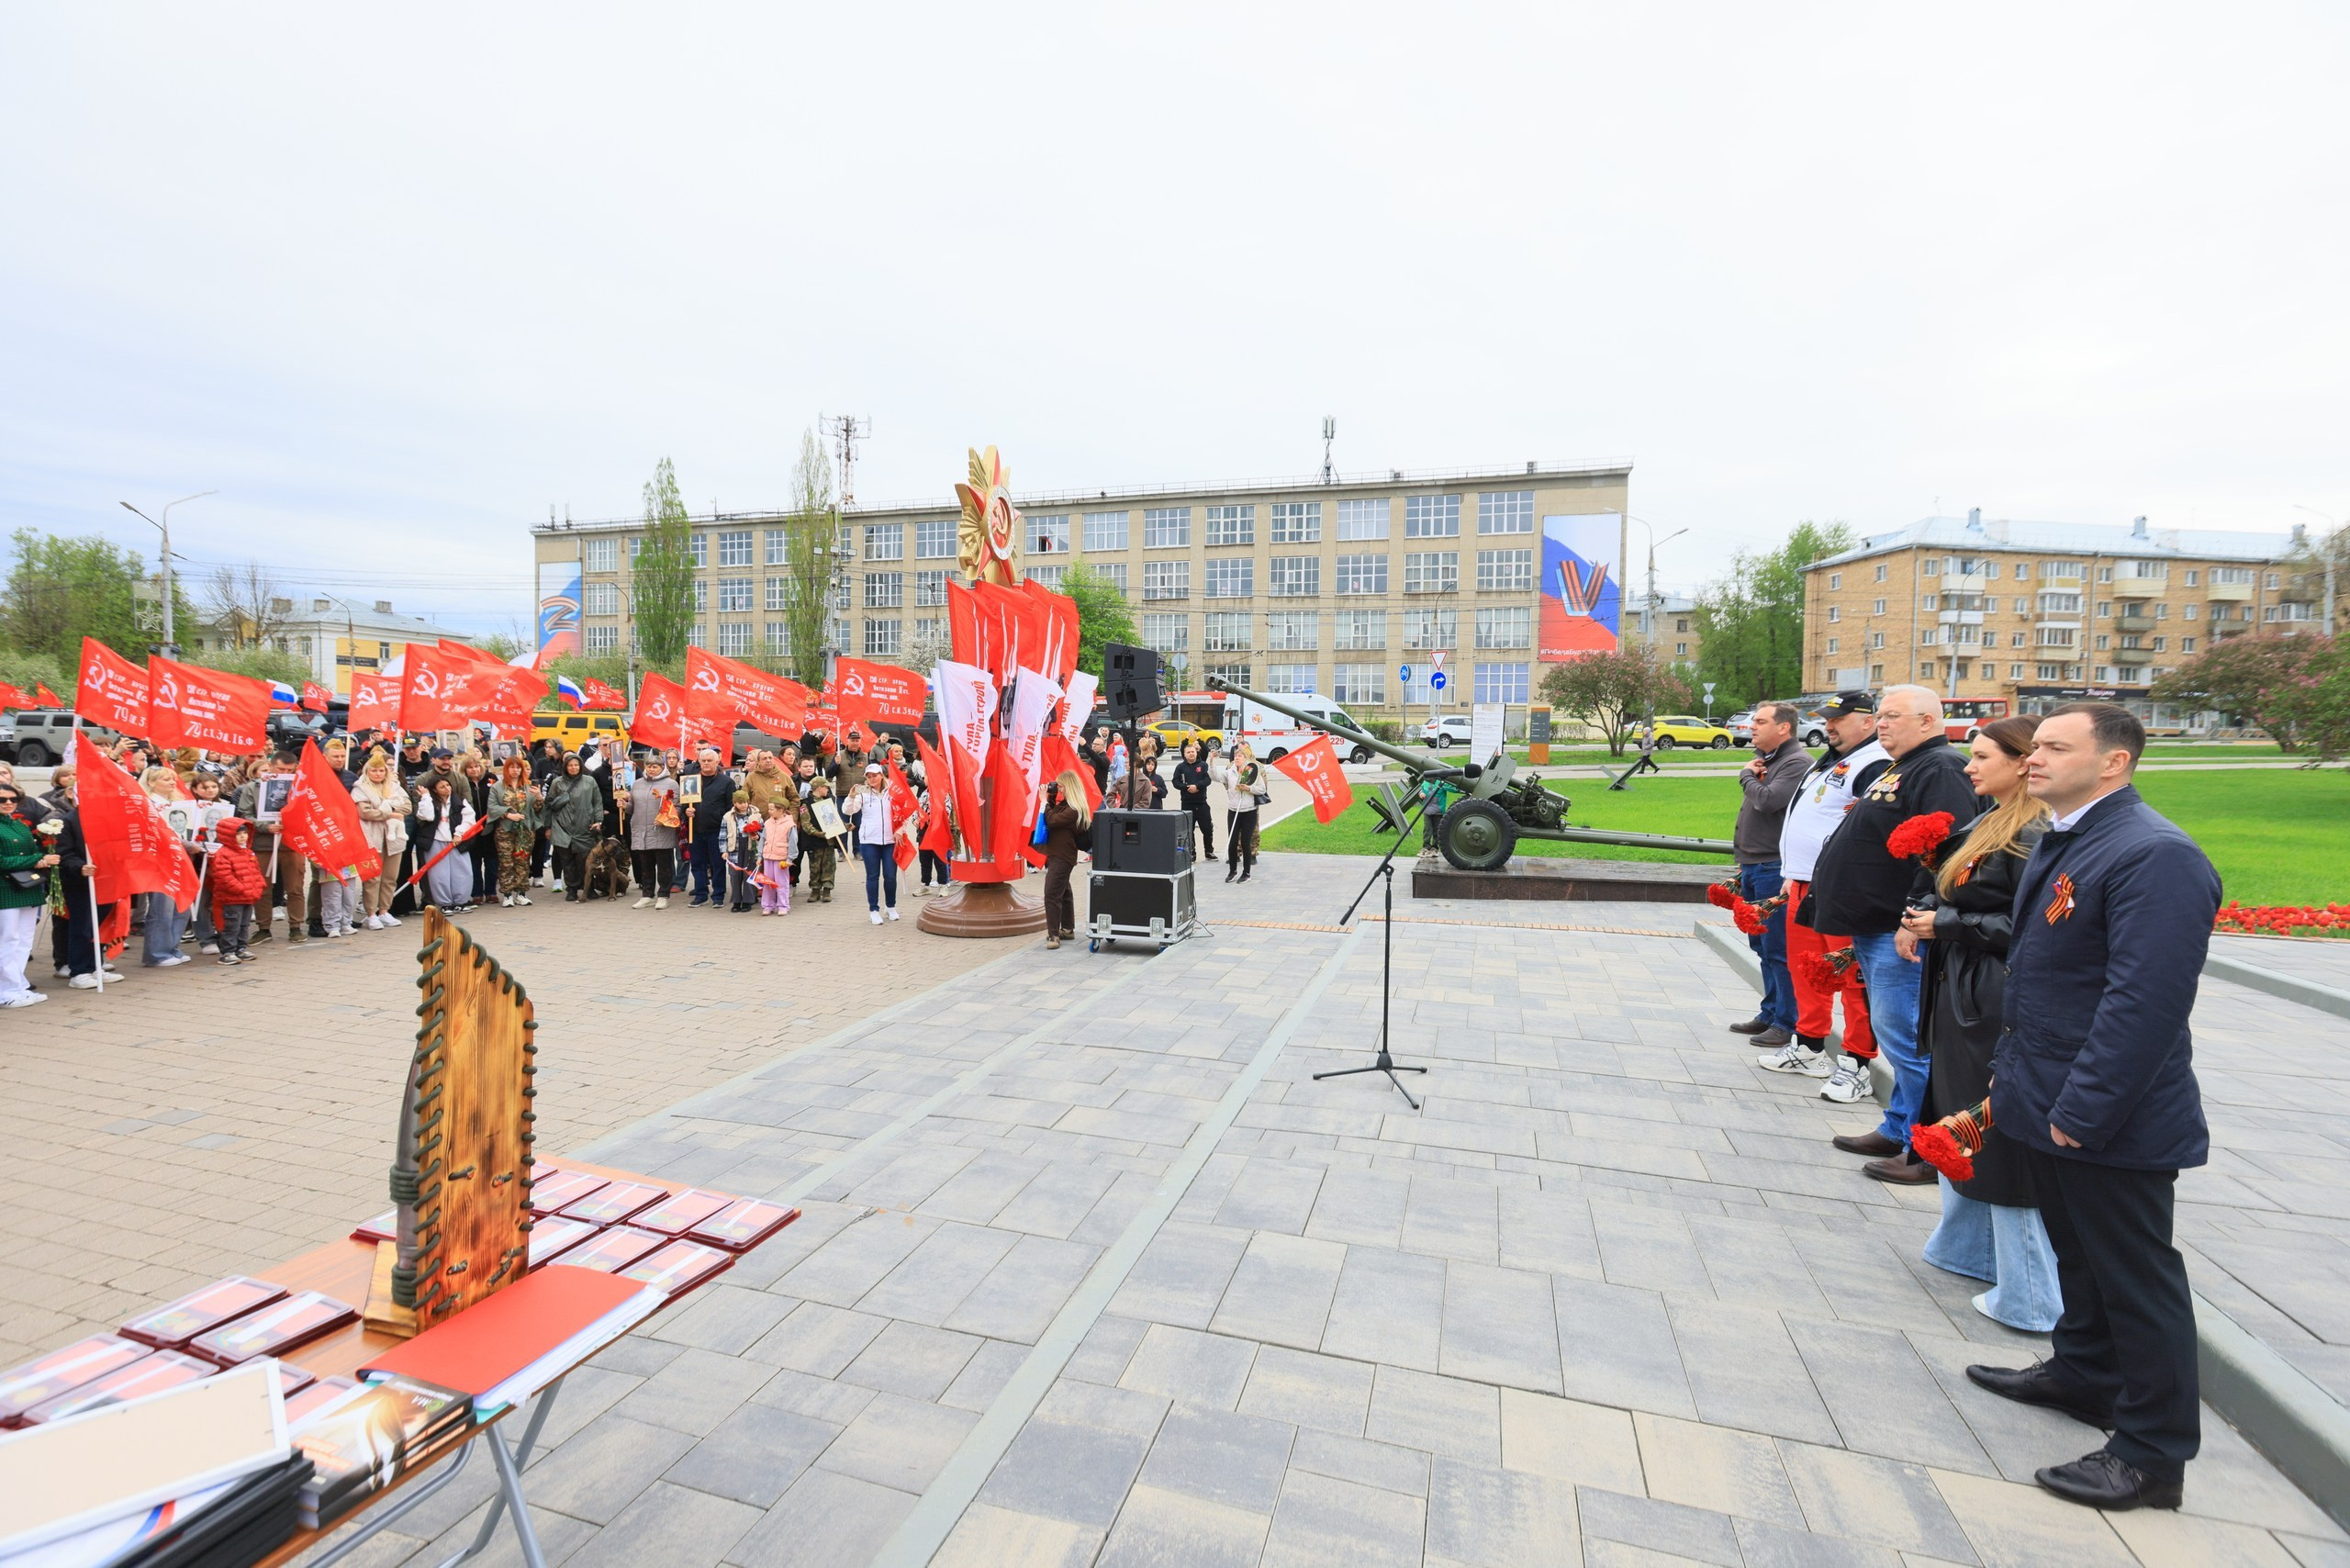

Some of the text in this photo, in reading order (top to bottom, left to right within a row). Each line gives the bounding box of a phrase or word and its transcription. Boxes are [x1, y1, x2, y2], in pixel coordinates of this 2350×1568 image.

[114, 704, 129, 722] 79
[734, 700, 748, 716] 79
[878, 702, 890, 715] 79
[185, 721, 202, 738] 79
[967, 722, 976, 751] ТУЛА
[1068, 724, 1079, 745] ЛЫ
[1022, 734, 1036, 763] ТУЛА
[1330, 737, 1345, 745] 229
[323, 817, 344, 842] ОРДЕНА
